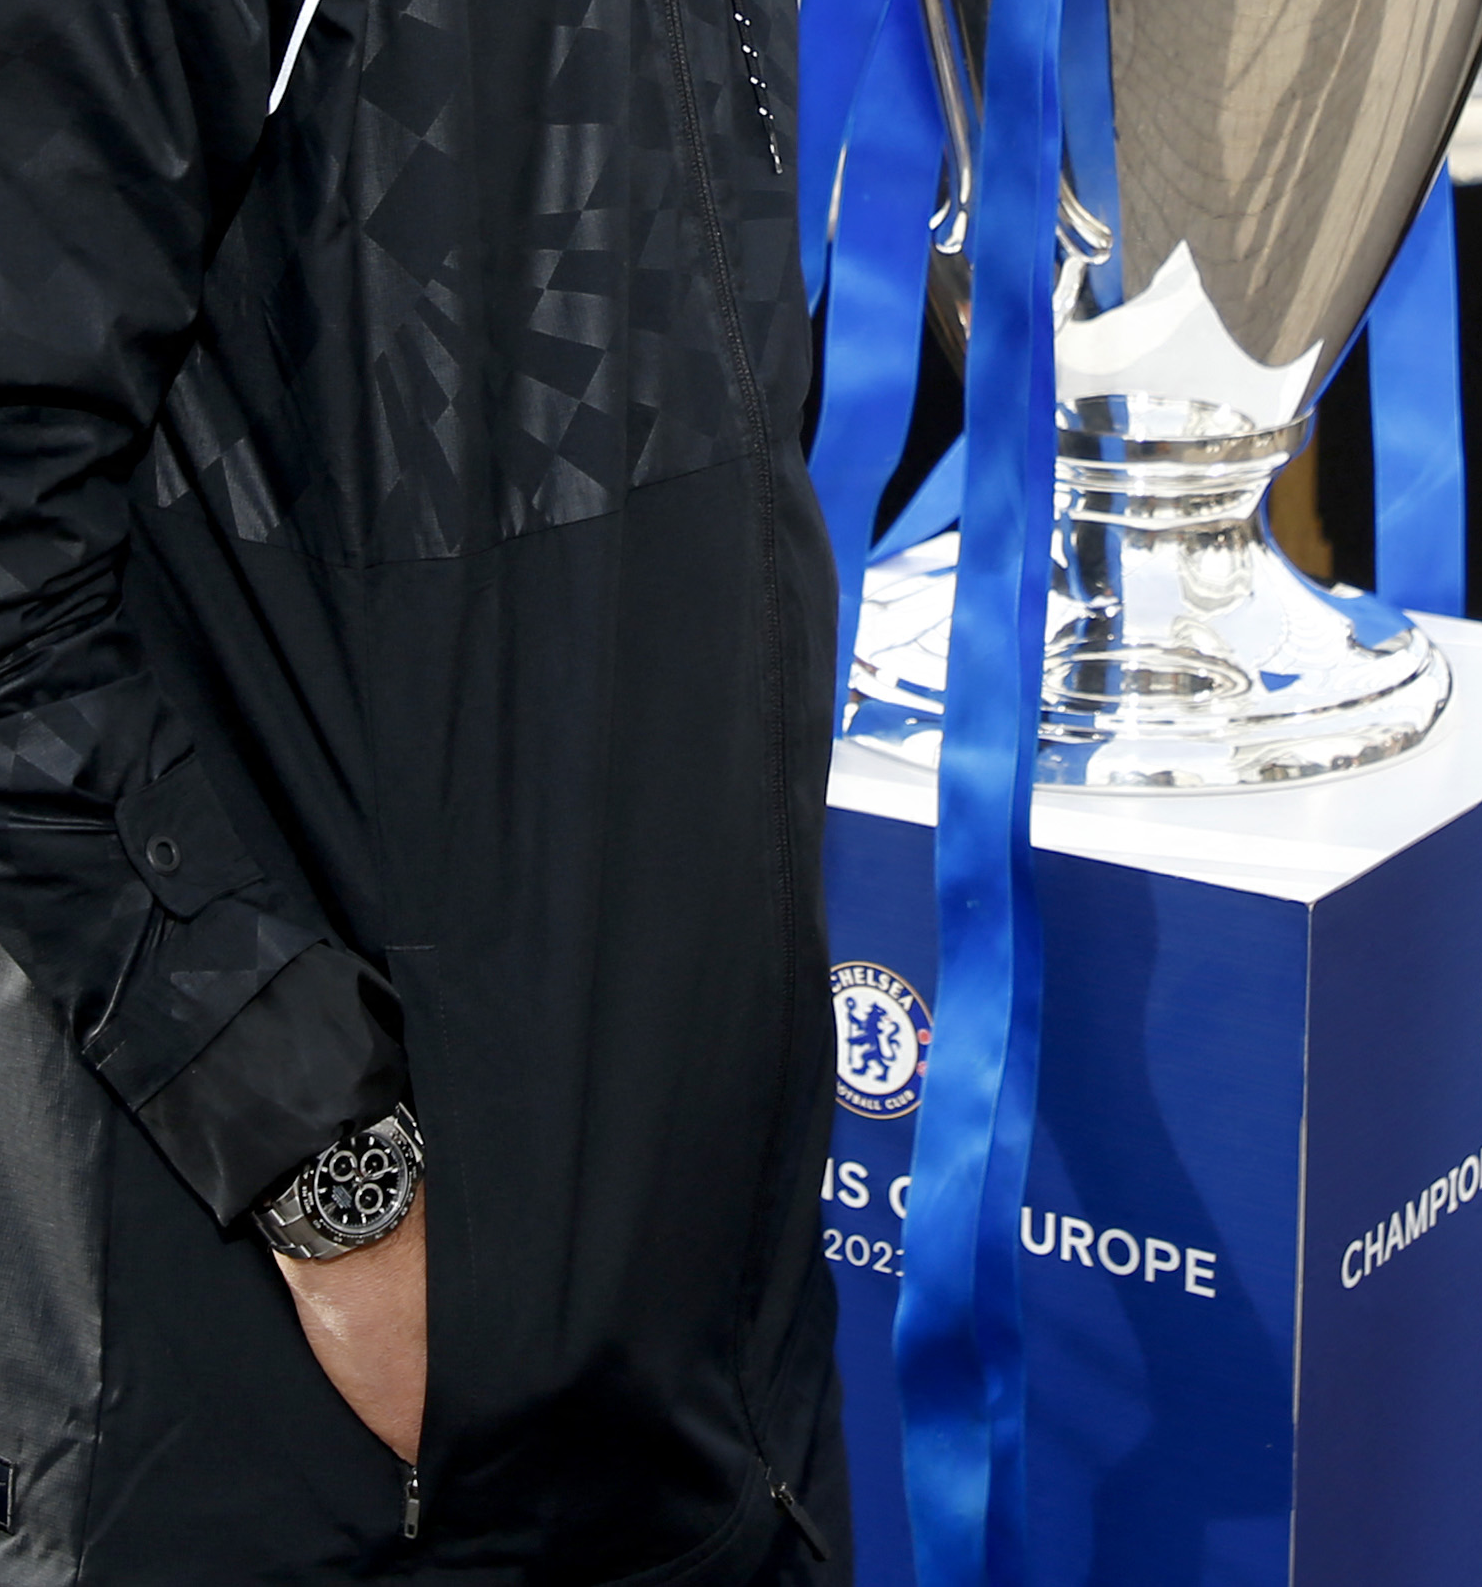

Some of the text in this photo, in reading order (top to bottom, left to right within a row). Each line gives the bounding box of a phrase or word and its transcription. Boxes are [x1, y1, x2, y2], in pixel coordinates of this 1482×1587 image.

[830, 967, 914, 1012] CHELSEA
[836, 1081, 915, 1110] OTBALL CLUB
[1020, 1206, 1217, 1298] UROPE
